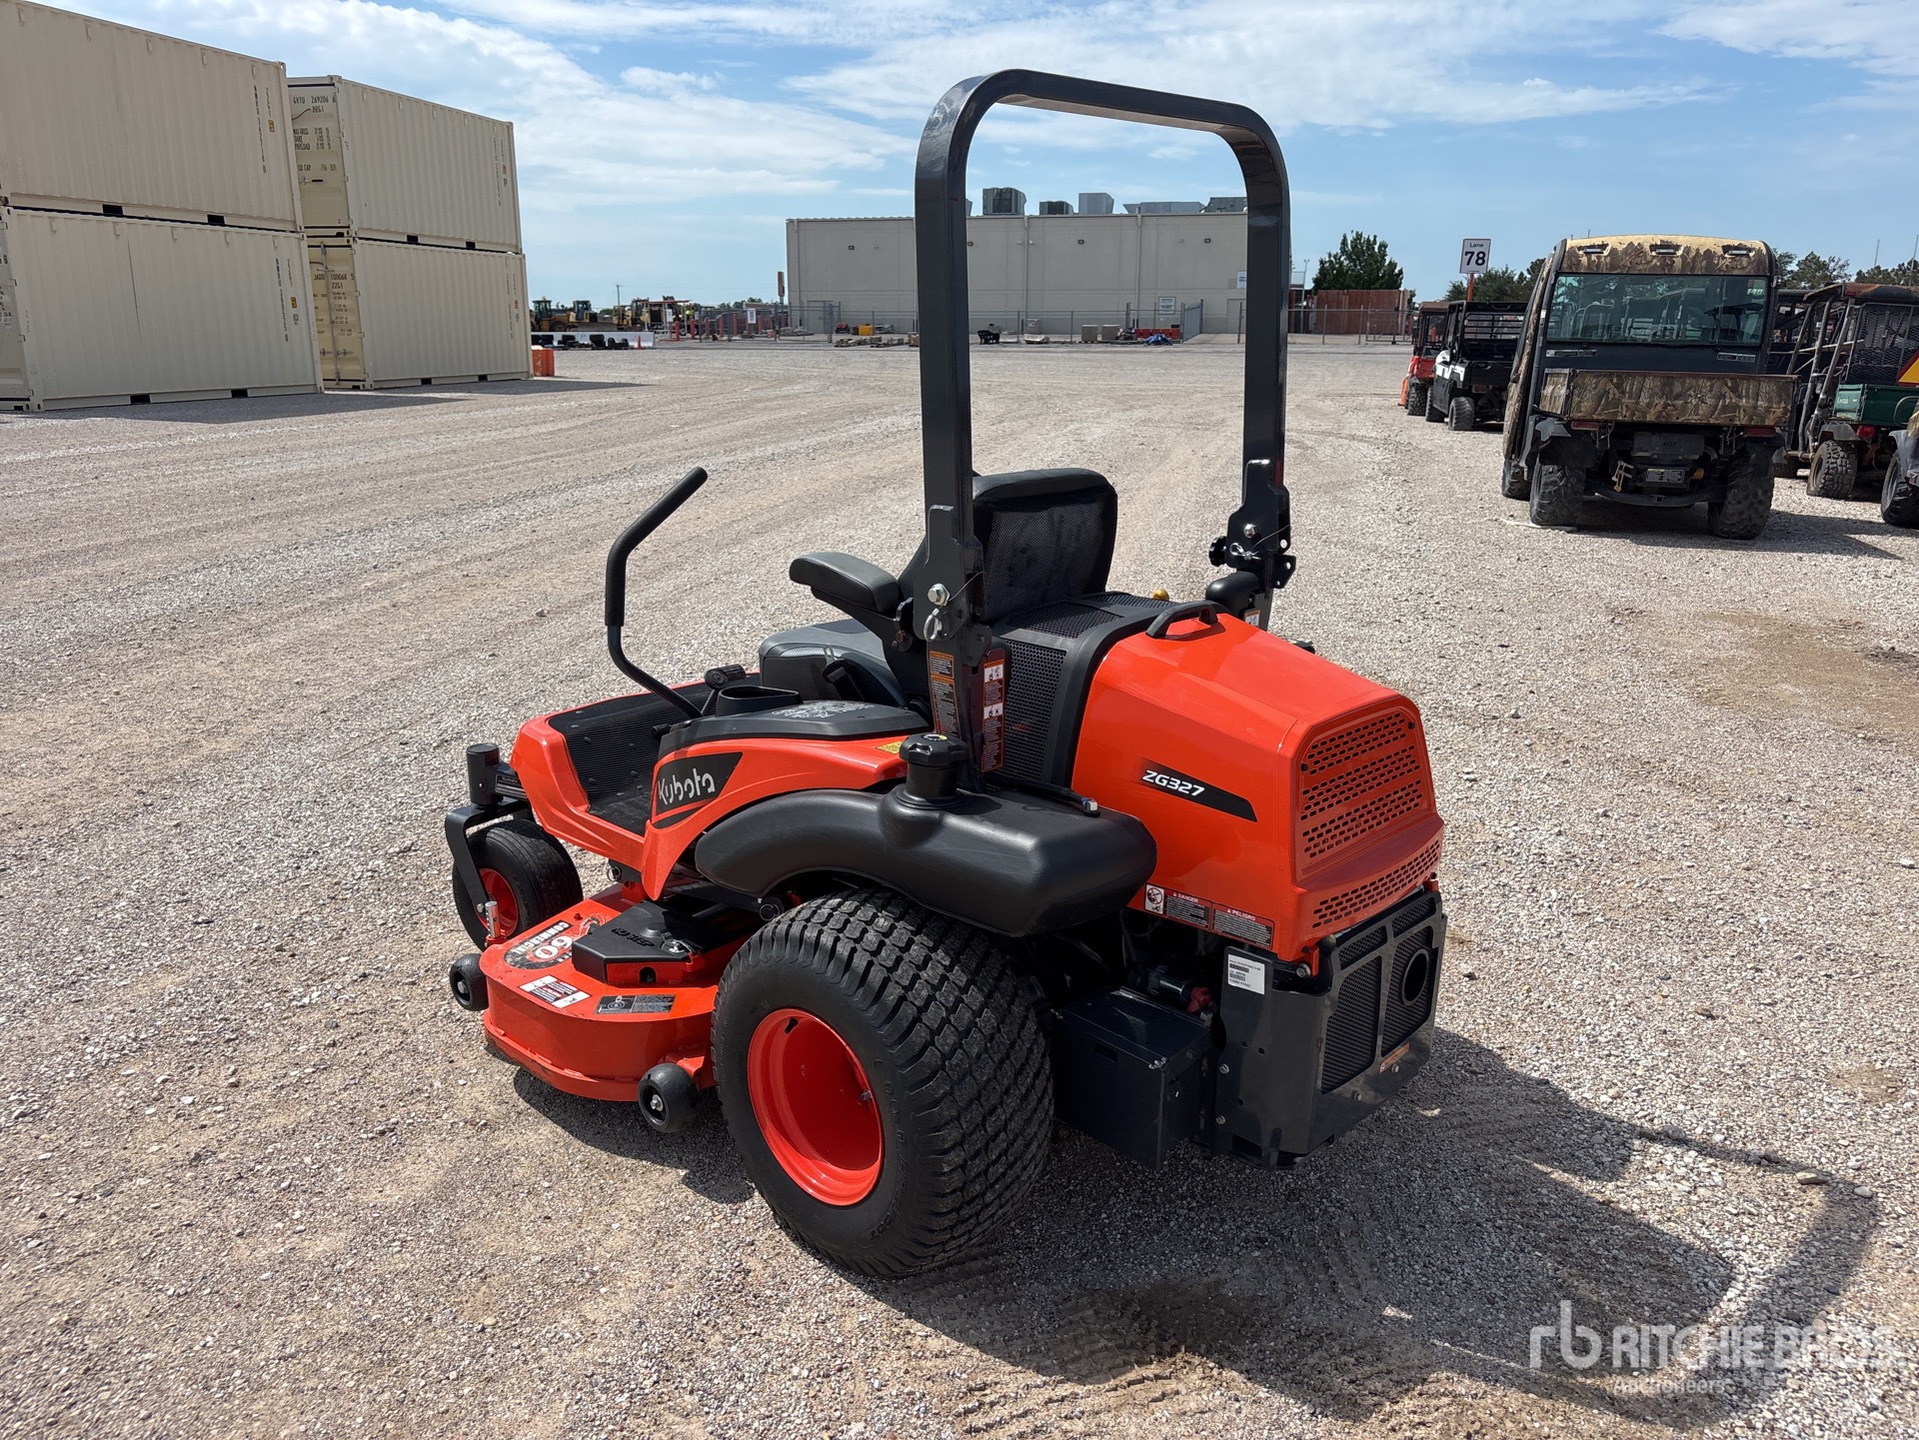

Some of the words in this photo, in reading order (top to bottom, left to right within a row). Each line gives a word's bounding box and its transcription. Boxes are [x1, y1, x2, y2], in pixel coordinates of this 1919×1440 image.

[1465, 251, 1486, 266] 78
[658, 768, 716, 806] Kubota
[1141, 769, 1206, 797] ZG327
[1178, 893, 1199, 903] DANGER
[1232, 910, 1256, 922] PELIGRO
[512, 922, 571, 955] COMMERCIAL
[534, 935, 573, 960] 60
